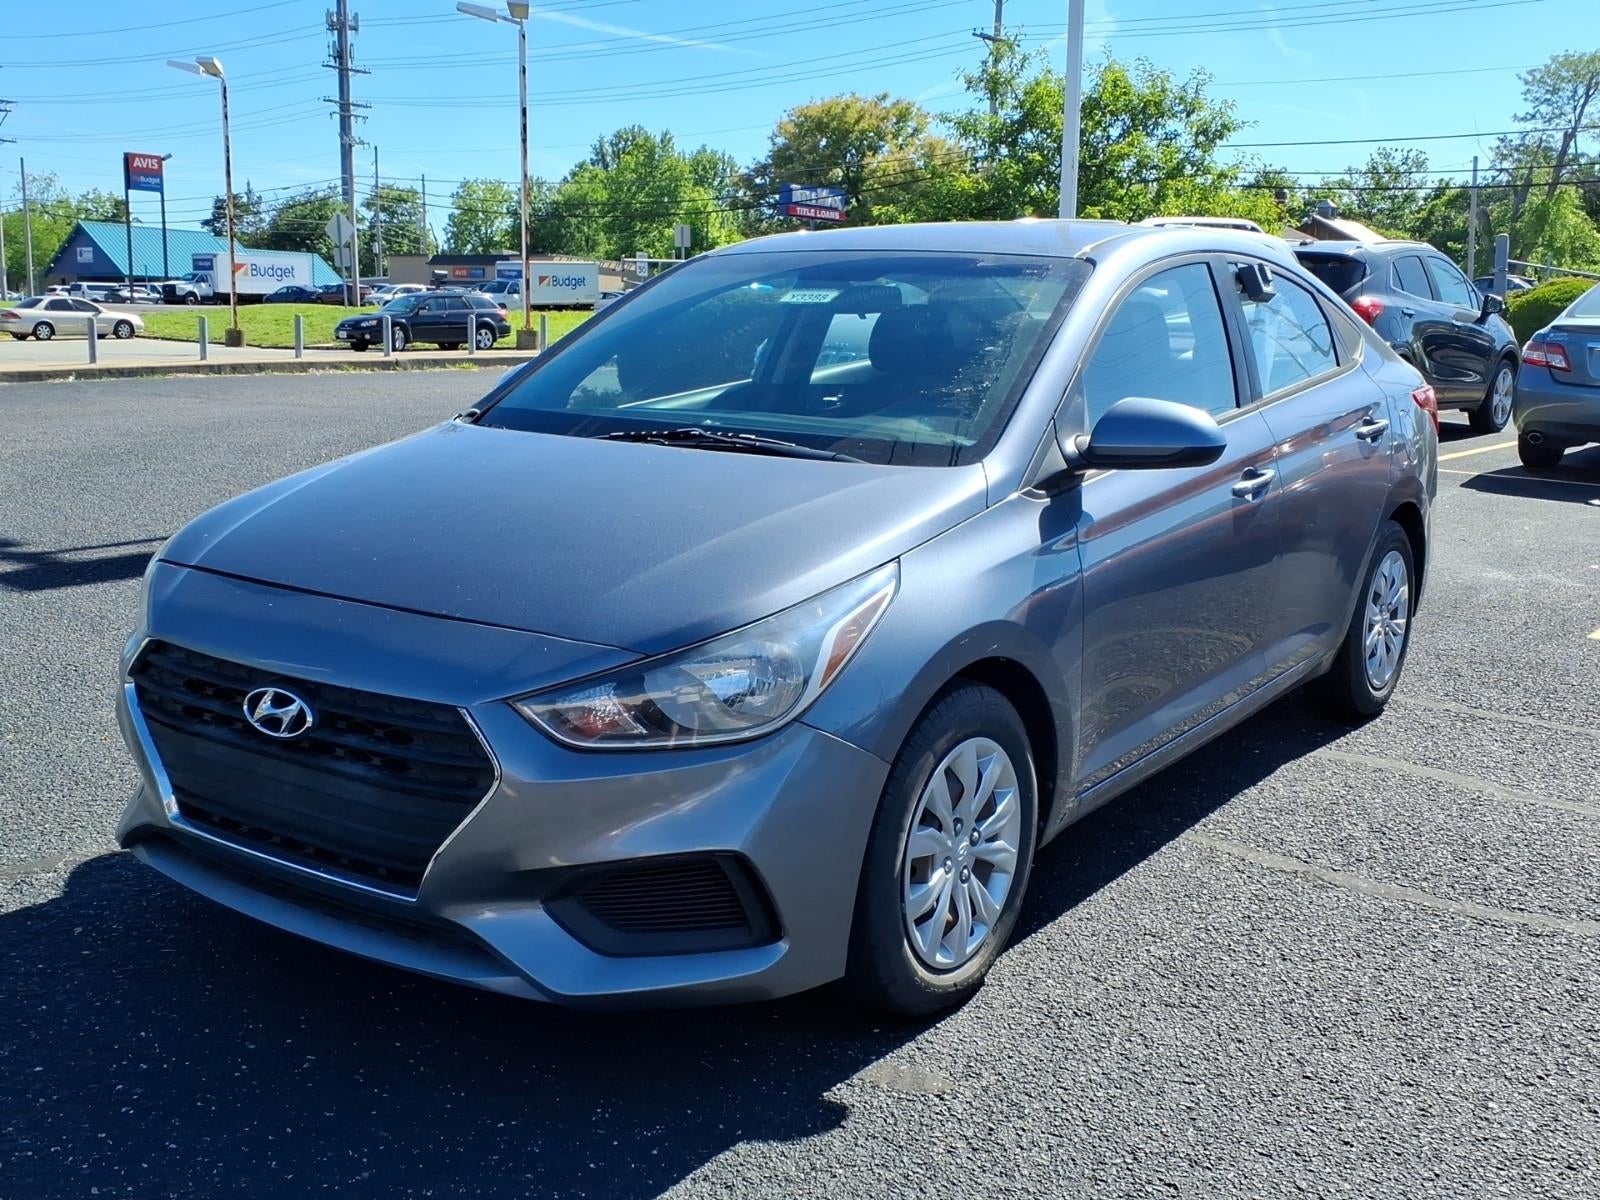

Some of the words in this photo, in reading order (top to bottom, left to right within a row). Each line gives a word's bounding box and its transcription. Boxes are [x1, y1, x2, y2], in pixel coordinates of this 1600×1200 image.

[133, 157, 158, 169] AVIS
[796, 207, 815, 217] TITLE
[816, 209, 840, 219] LOANS
[250, 263, 295, 281] Budget
[551, 275, 586, 290] Budget
